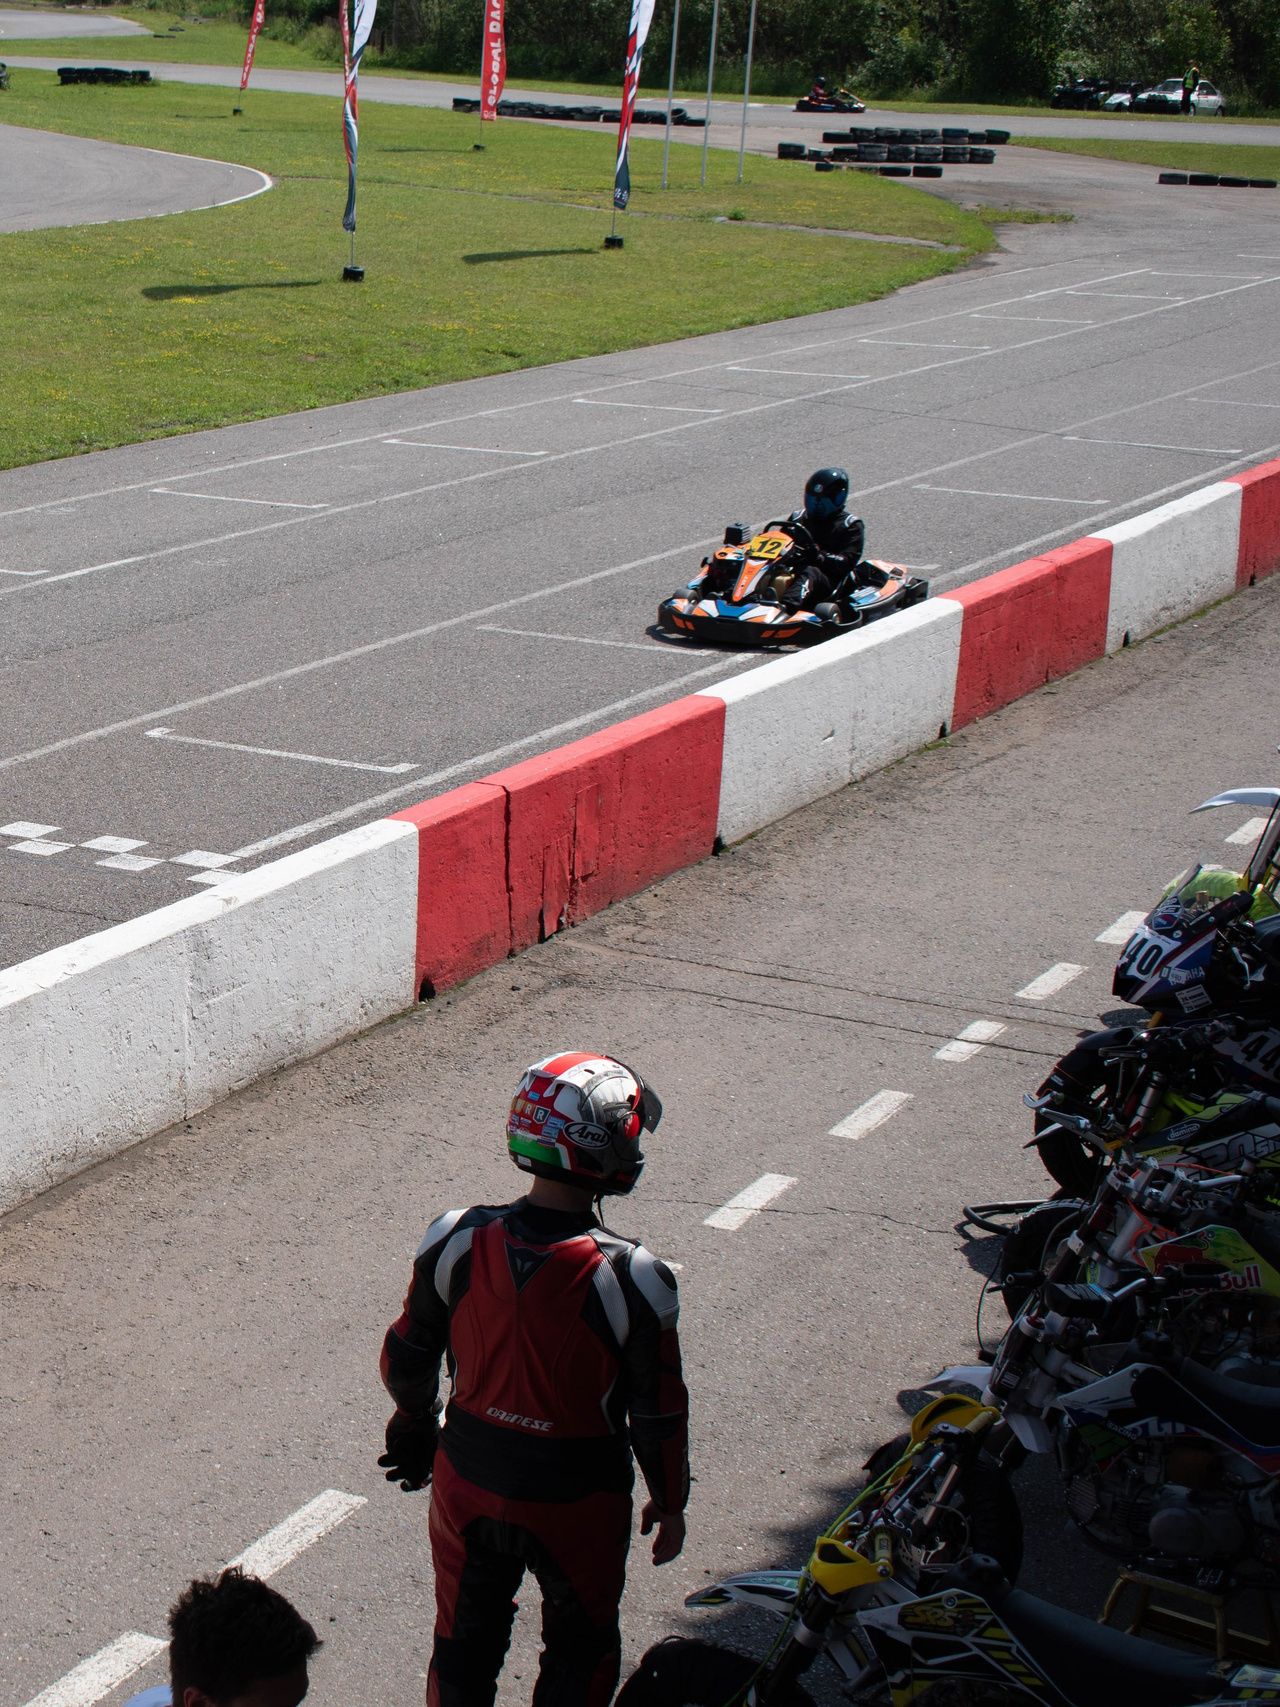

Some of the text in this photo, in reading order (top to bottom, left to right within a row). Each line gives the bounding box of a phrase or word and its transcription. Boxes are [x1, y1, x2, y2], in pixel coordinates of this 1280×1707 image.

[487, 38, 502, 106] GLOBAL
[756, 540, 782, 555] 12
[1240, 1034, 1280, 1081] 44
[568, 1124, 607, 1143] Arai
[1105, 1420, 1138, 1440] RACING
